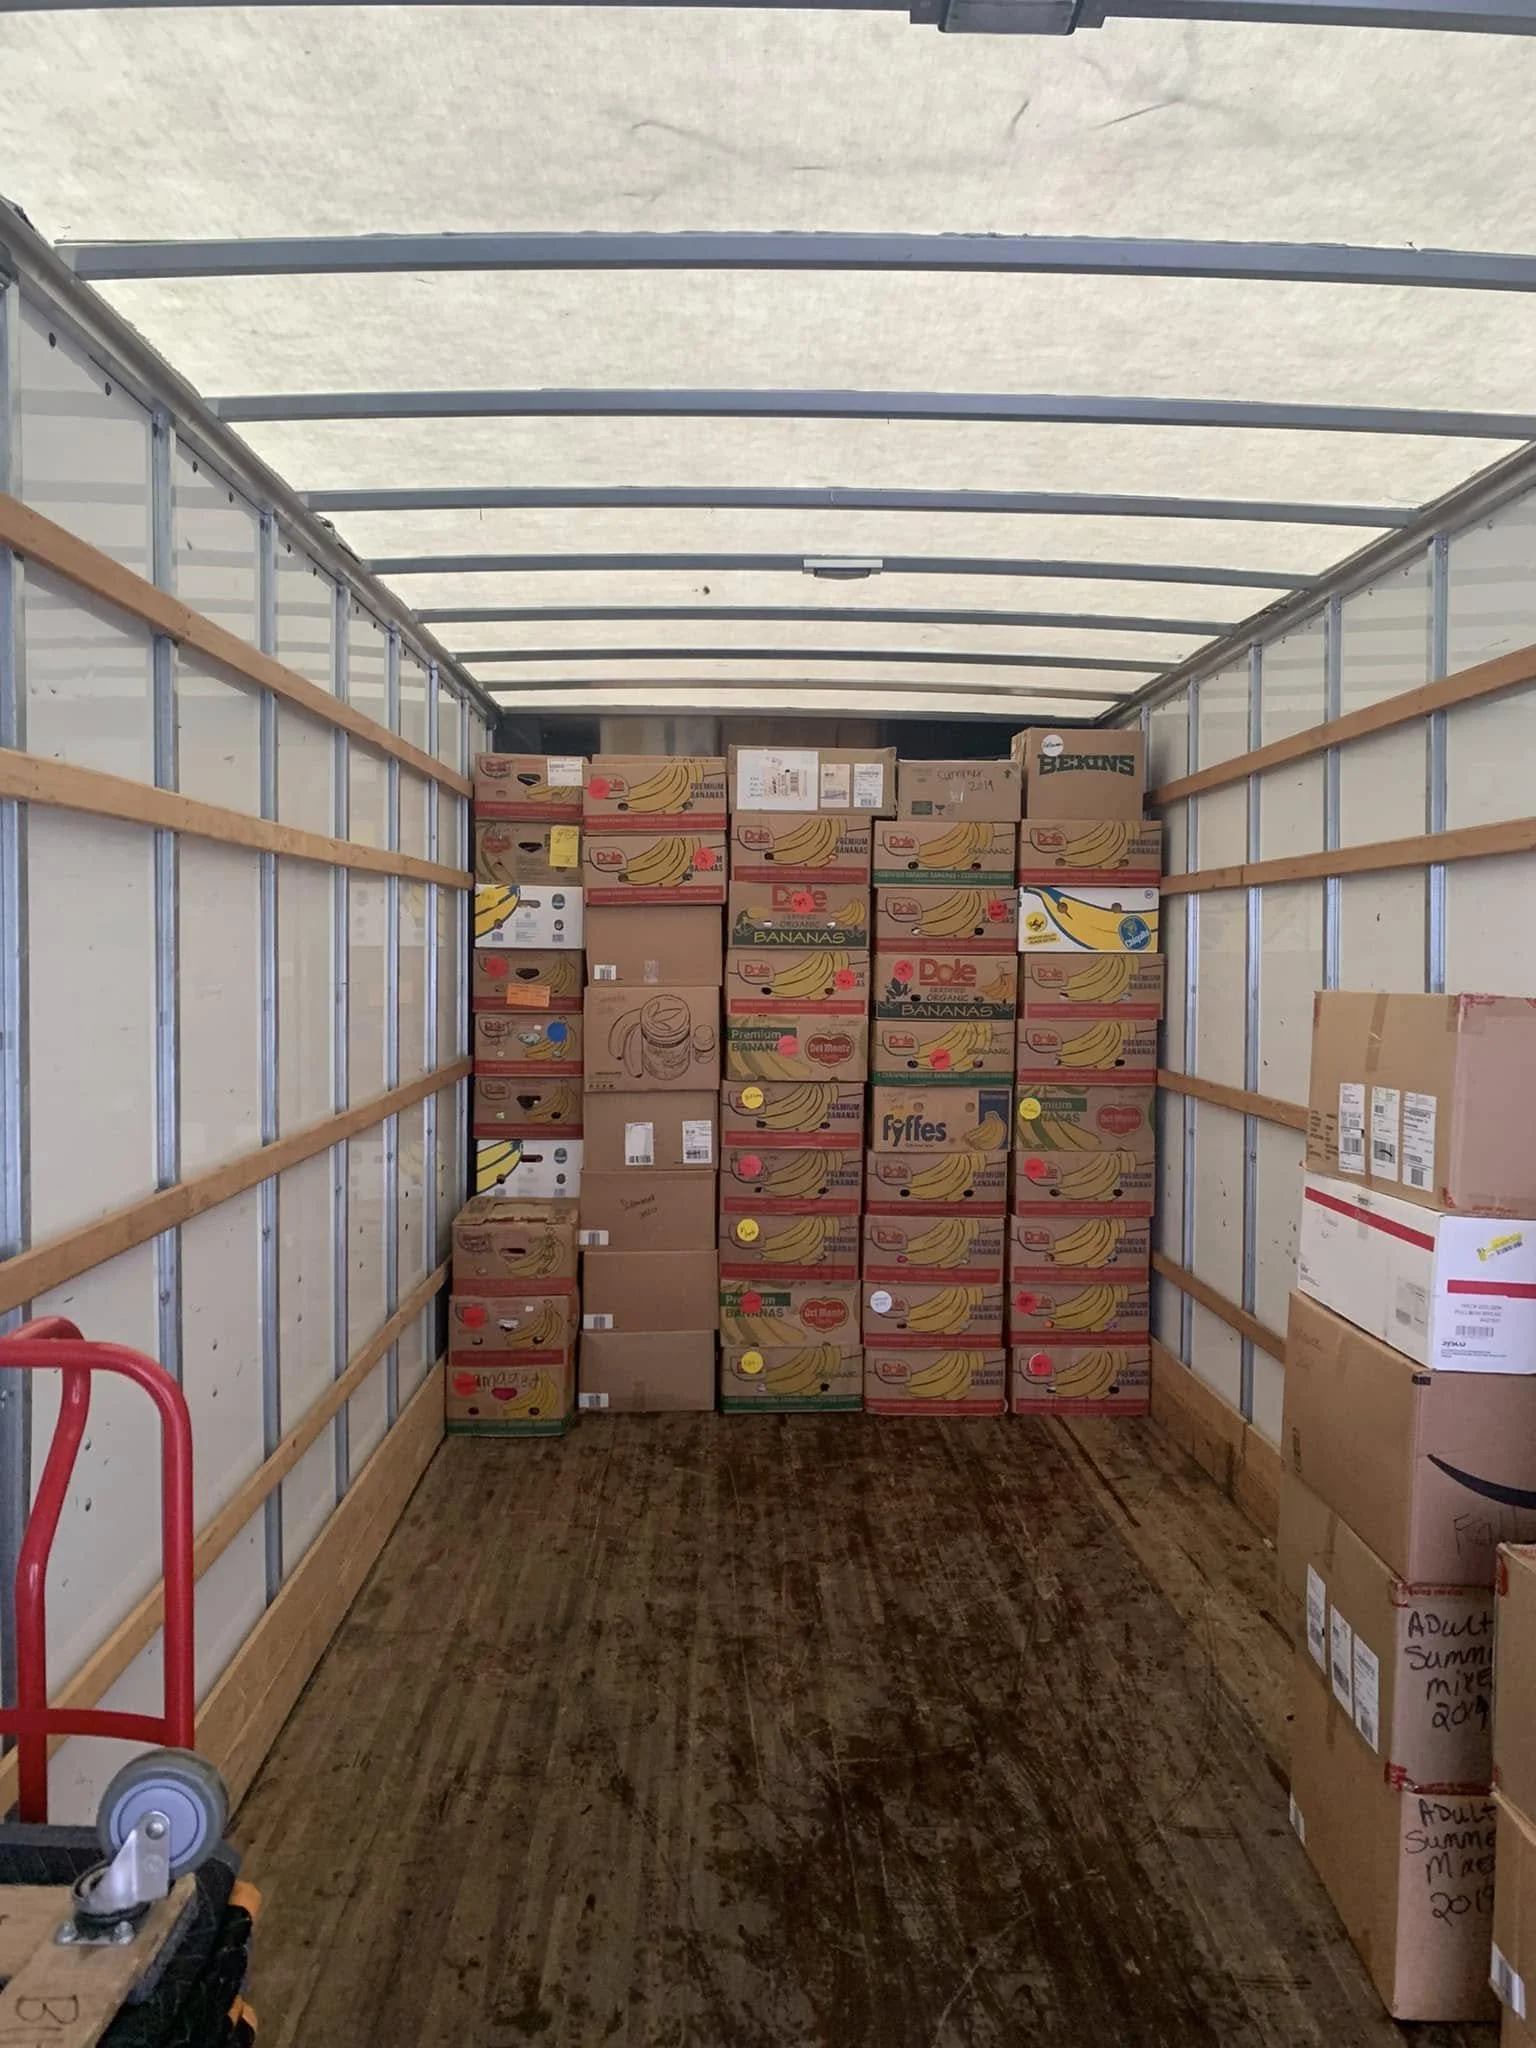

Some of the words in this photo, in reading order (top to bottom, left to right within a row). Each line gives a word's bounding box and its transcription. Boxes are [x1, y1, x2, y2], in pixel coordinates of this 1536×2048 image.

[1038, 754, 1134, 776] BEKINS
[691, 791, 724, 799] BANANAS
[744, 830, 769, 841] Dole
[1036, 831, 1063, 842] Dole
[835, 837, 868, 845] PREMIUM
[889, 836, 914, 846] Dole
[835, 846, 868, 854] BANANAS
[596, 851, 623, 862] Dole
[893, 903, 917, 912] Dole
[754, 932, 845, 944] BANANAS
[920, 958, 977, 981] Dole
[1037, 968, 1063, 978] Dole
[901, 1006, 993, 1016] BANANAS
[732, 1029, 781, 1039] Premium
[1032, 1033, 1058, 1043] Dole
[1404, 1645, 1493, 1670] Summ
[1405, 1830, 1496, 1854] Summe
